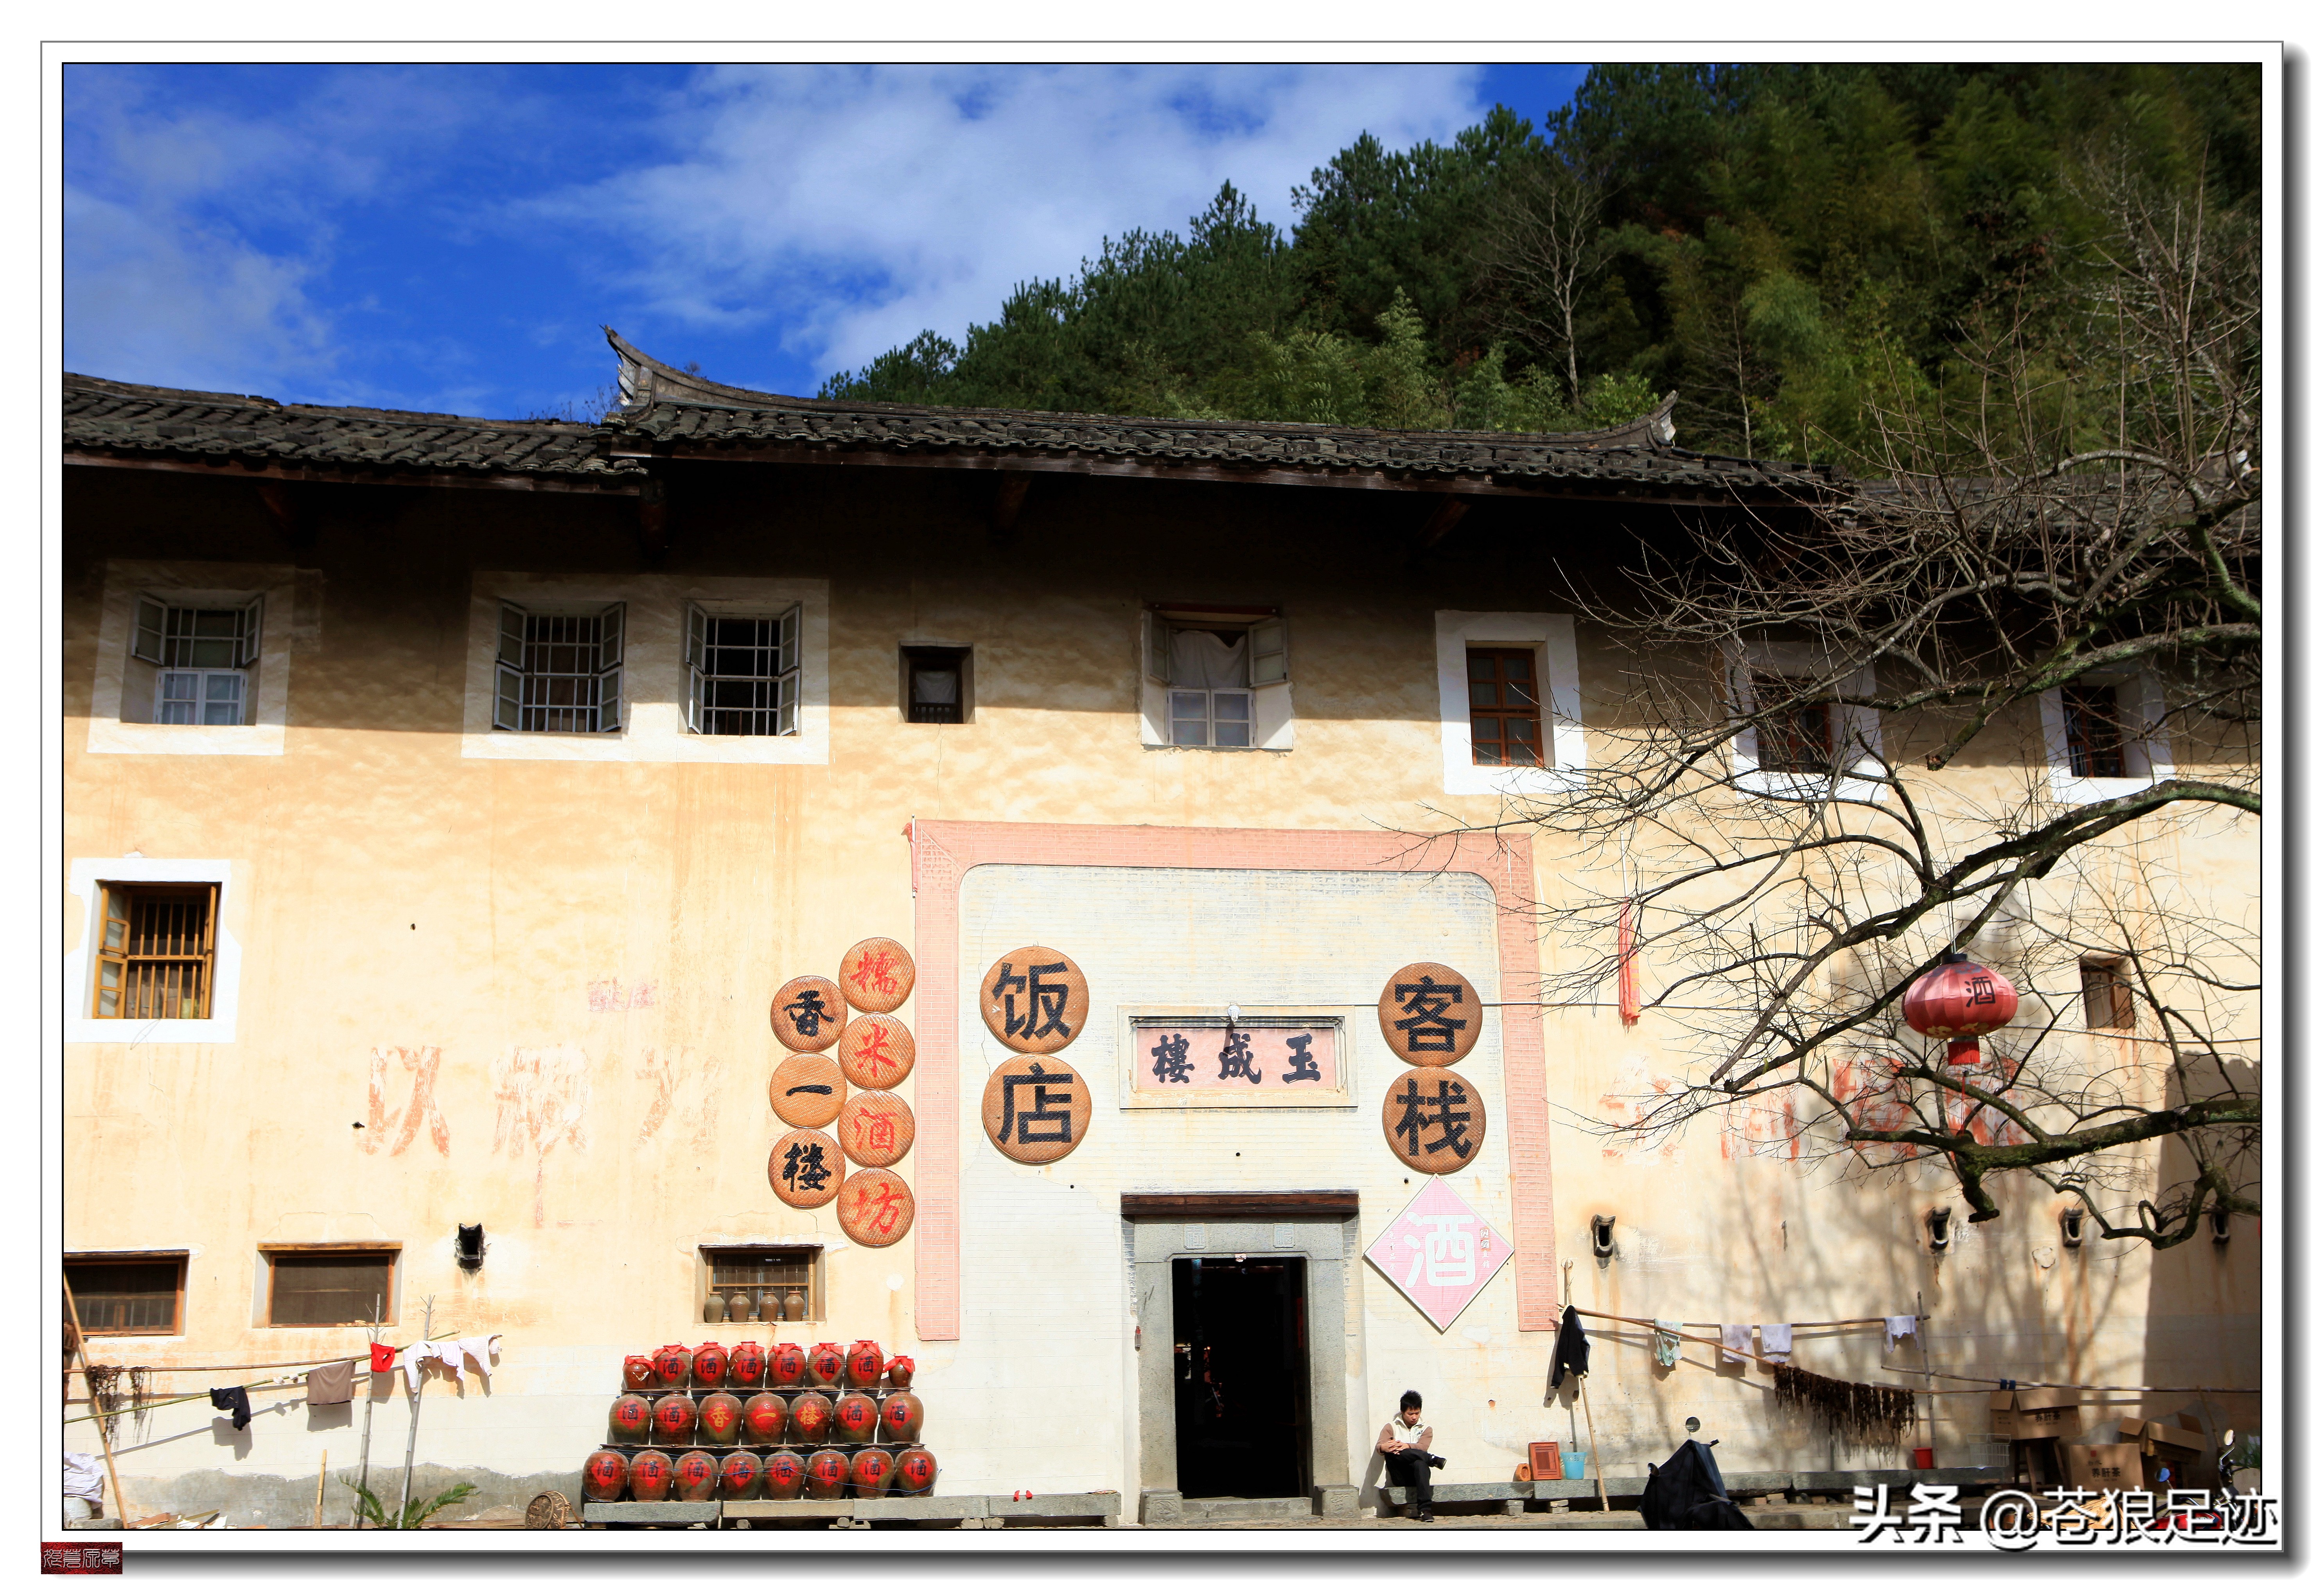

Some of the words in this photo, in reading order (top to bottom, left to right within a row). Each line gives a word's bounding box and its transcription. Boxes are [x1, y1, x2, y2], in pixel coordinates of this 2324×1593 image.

[1965, 976, 1995, 1008] 酒
[991, 961, 1074, 1145] 饭店
[1394, 975, 1473, 1159] 客栈
[850, 951, 905, 1235] 糯米酒坊
[1403, 1211, 1476, 1288] 酒
[663, 1358, 678, 1374] 酒
[702, 1357, 716, 1374] 酒
[742, 1358, 756, 1374] 酒
[781, 1357, 796, 1374] 酒
[820, 1357, 835, 1374] 酒
[858, 1356, 873, 1372] 酒
[623, 1404, 638, 1420] 酒
[665, 1406, 679, 1423] 酒
[847, 1405, 862, 1422] 酒
[890, 1405, 905, 1422] 酒
[2035, 1411, 2060, 1422] 养肝茶
[598, 1461, 613, 1478] 酒
[643, 1462, 657, 1478] 酒
[688, 1462, 703, 1478] 酒
[733, 1462, 748, 1479] 酒
[776, 1461, 791, 1478] 酒
[822, 1460, 837, 1478] 酒
[865, 1459, 880, 1476] 酒
[912, 1459, 926, 1476] 酒
[2092, 1467, 2121, 1478] 养肝茶
